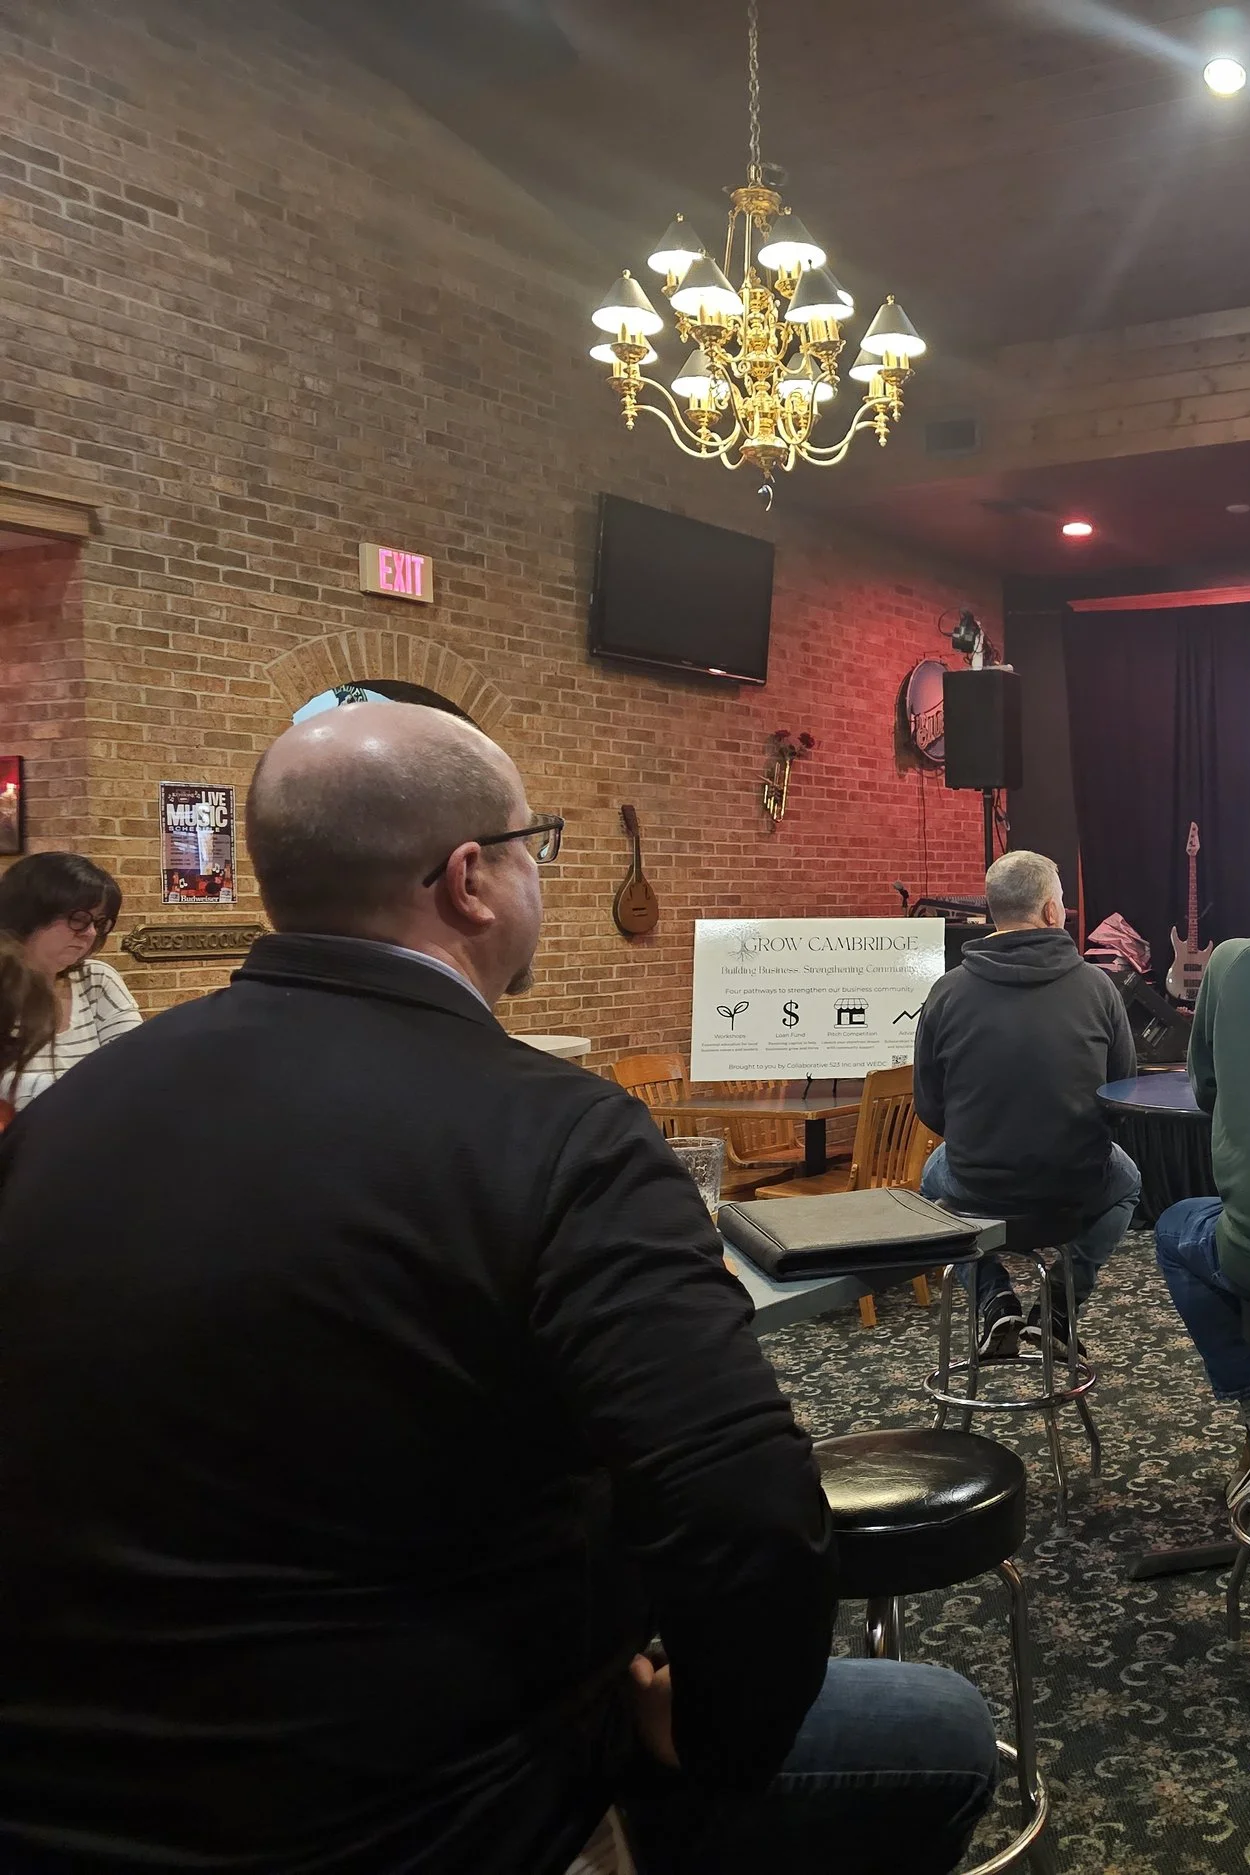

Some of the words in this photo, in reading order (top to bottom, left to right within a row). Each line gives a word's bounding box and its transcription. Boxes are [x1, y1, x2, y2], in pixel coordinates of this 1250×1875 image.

[379, 548, 424, 596] EXIT
[202, 791, 227, 807] LIVE
[166, 803, 228, 828] MUSIC
[147, 931, 255, 951] RESTROOMS
[743, 936, 803, 952] GROW
[808, 936, 919, 952] CAMBRIDGE
[721, 966, 757, 977] Building
[803, 964, 864, 976] Strengthening
[743, 988, 778, 996] pathways
[787, 986, 827, 995] strengthen
[842, 985, 873, 993] business
[874, 985, 914, 994] community
[728, 1063, 756, 1071] Brought
[764, 1063, 777, 1071] you
[777, 1062, 785, 1070] by
[786, 1061, 828, 1069] Collaborative
